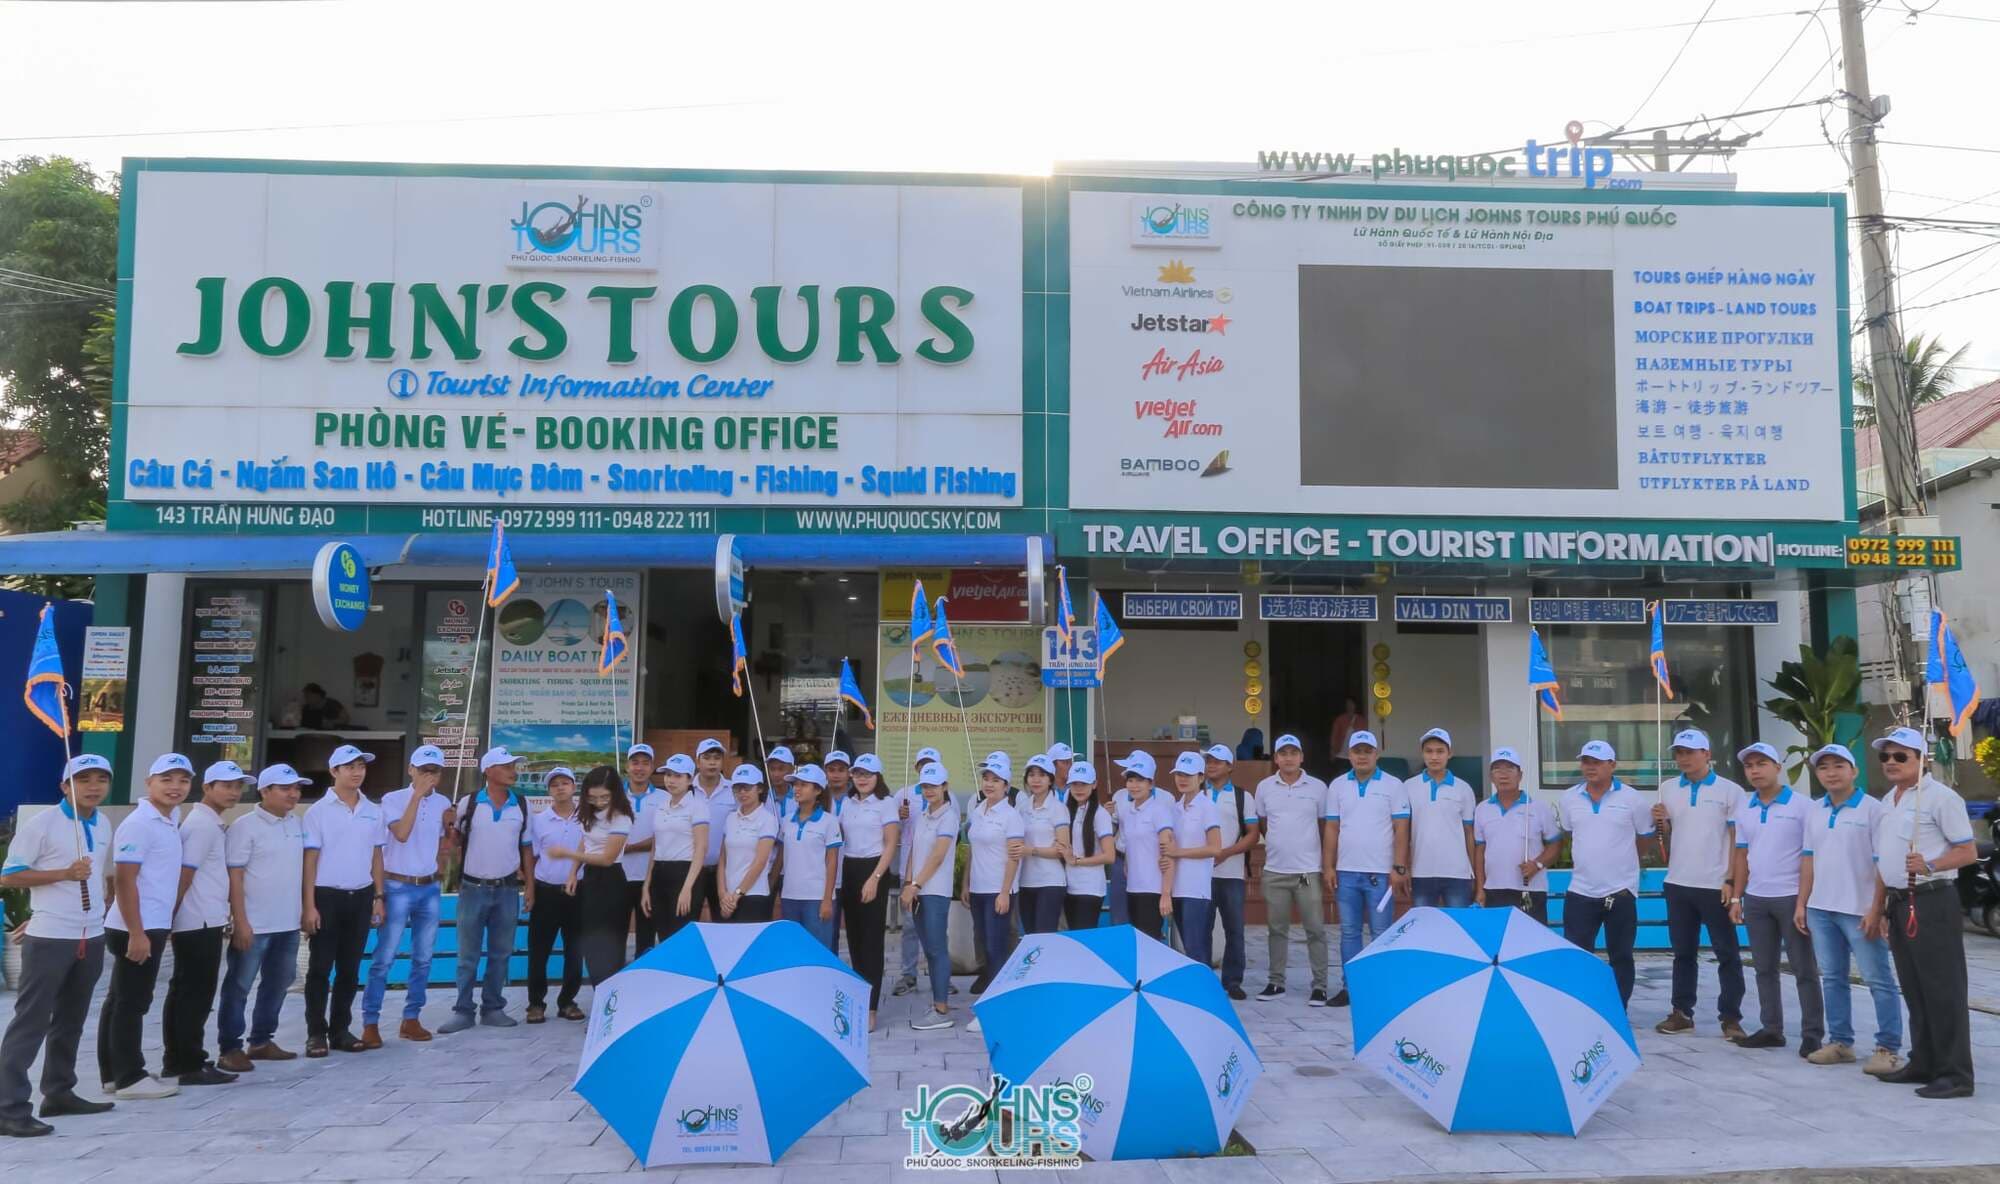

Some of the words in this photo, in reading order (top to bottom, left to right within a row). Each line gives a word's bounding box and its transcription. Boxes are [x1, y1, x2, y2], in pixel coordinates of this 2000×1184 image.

[1233, 200, 1286, 217] CÔNG
[1292, 205, 1312, 219] TY
[1317, 205, 1362, 220] TNHH
[1367, 206, 1388, 221] DV
[1394, 207, 1417, 221] DU
[1422, 207, 1460, 227] LỊCH
[1465, 208, 1522, 224] JOHNS
[1527, 209, 1581, 225] TOURS
[1587, 205, 1620, 225] PHÚ
[1625, 203, 1677, 226] QUỐC
[1369, 227, 1399, 238] Hành
[1403, 226, 1433, 238] Quốc
[1437, 226, 1452, 238] Tế
[1453, 230, 1461, 239] &
[1633, 271, 1680, 284] TOURS
[1685, 266, 1723, 284] GHÉP
[1728, 268, 1772, 285] HÀNG
[1776, 268, 1815, 285] NGÀY
[1121, 286, 1170, 297] Vietnam
[1172, 287, 1214, 298] Airlines
[1633, 301, 1672, 314] BOAT
[1770, 303, 1817, 316] TOURS
[176, 276, 568, 361] JOHN'S
[587, 284, 976, 365] TOURS
[1131, 313, 1210, 333] Jetstar
[1635, 330, 1718, 344] МОРСКИЕ
[1721, 332, 1814, 345] ПРОГУЛКИ
[1636, 357, 1737, 371] НАЗЕМНЫЕ
[1741, 359, 1793, 372] ТУРЫ
[427, 371, 512, 397] Tourist
[519, 373, 680, 401] Information
[687, 374, 775, 398] Center
[315, 406, 446, 449] PHÒNG
[536, 416, 704, 451] BOOKING
[714, 415, 839, 451] OFFICE
[1637, 424, 1667, 438] 보트
[1673, 424, 1701, 440] 여행
[1754, 424, 1782, 441] 여행
[1120, 458, 1200, 472] BAMBOO
[1638, 448, 1767, 464] BÅTUTFLYKTER
[129, 458, 176, 488] Câu
[183, 458, 213, 488] Cá
[236, 455, 306, 492] Ngắm
[313, 461, 359, 489] San
[366, 460, 397, 489] Hô
[420, 460, 465, 490] Câu
[472, 462, 523, 497] Mực
[607, 463, 734, 497] Snorkeling
[756, 465, 838, 497] Fishing
[861, 465, 927, 497] Squid
[934, 466, 1017, 498] Fishing
[1639, 477, 1737, 490] UTFLYKTER
[1741, 474, 1760, 490] PÅ
[1764, 479, 1811, 491] LAND
[156, 506, 186, 525] 143
[247, 504, 293, 525] HƯNG
[298, 507, 335, 529] ĐẠO
[502, 509, 543, 529] 0972
[546, 509, 576, 529] 999
[657, 511, 685, 530] 222
[689, 511, 710, 530] 111
[796, 510, 1001, 533] WWW.PHUQUOCSKY.COM
[1083, 525, 1208, 554] TRAVEL
[1217, 526, 1340, 557] OFFICE
[1367, 528, 1515, 558] TOURIST
[1523, 530, 1769, 563] INFORMATION
[1776, 543, 1844, 558] HOTLINE:
[1849, 538, 1889, 551] 0972
[1895, 538, 1925, 551] 999
[1931, 539, 1955, 552] 111
[1849, 552, 1891, 565] 0948
[1896, 553, 1926, 566] 222
[1932, 553, 1957, 566] 111
[1127, 600, 1177, 616] ВЫБЕРИ
[1180, 597, 1213, 616] СВОЙ
[1217, 600, 1238, 617] ТУР
[1401, 599, 1437, 618] VÄLJ
[1442, 603, 1471, 619] DIN
[1476, 604, 1505, 619] TUR
[1046, 630, 1098, 660] 143
[501, 650, 543, 662] DAILY
[548, 650, 587, 662] BOAT
[971, 712, 1042, 724] ЭКСКУРСИИ
